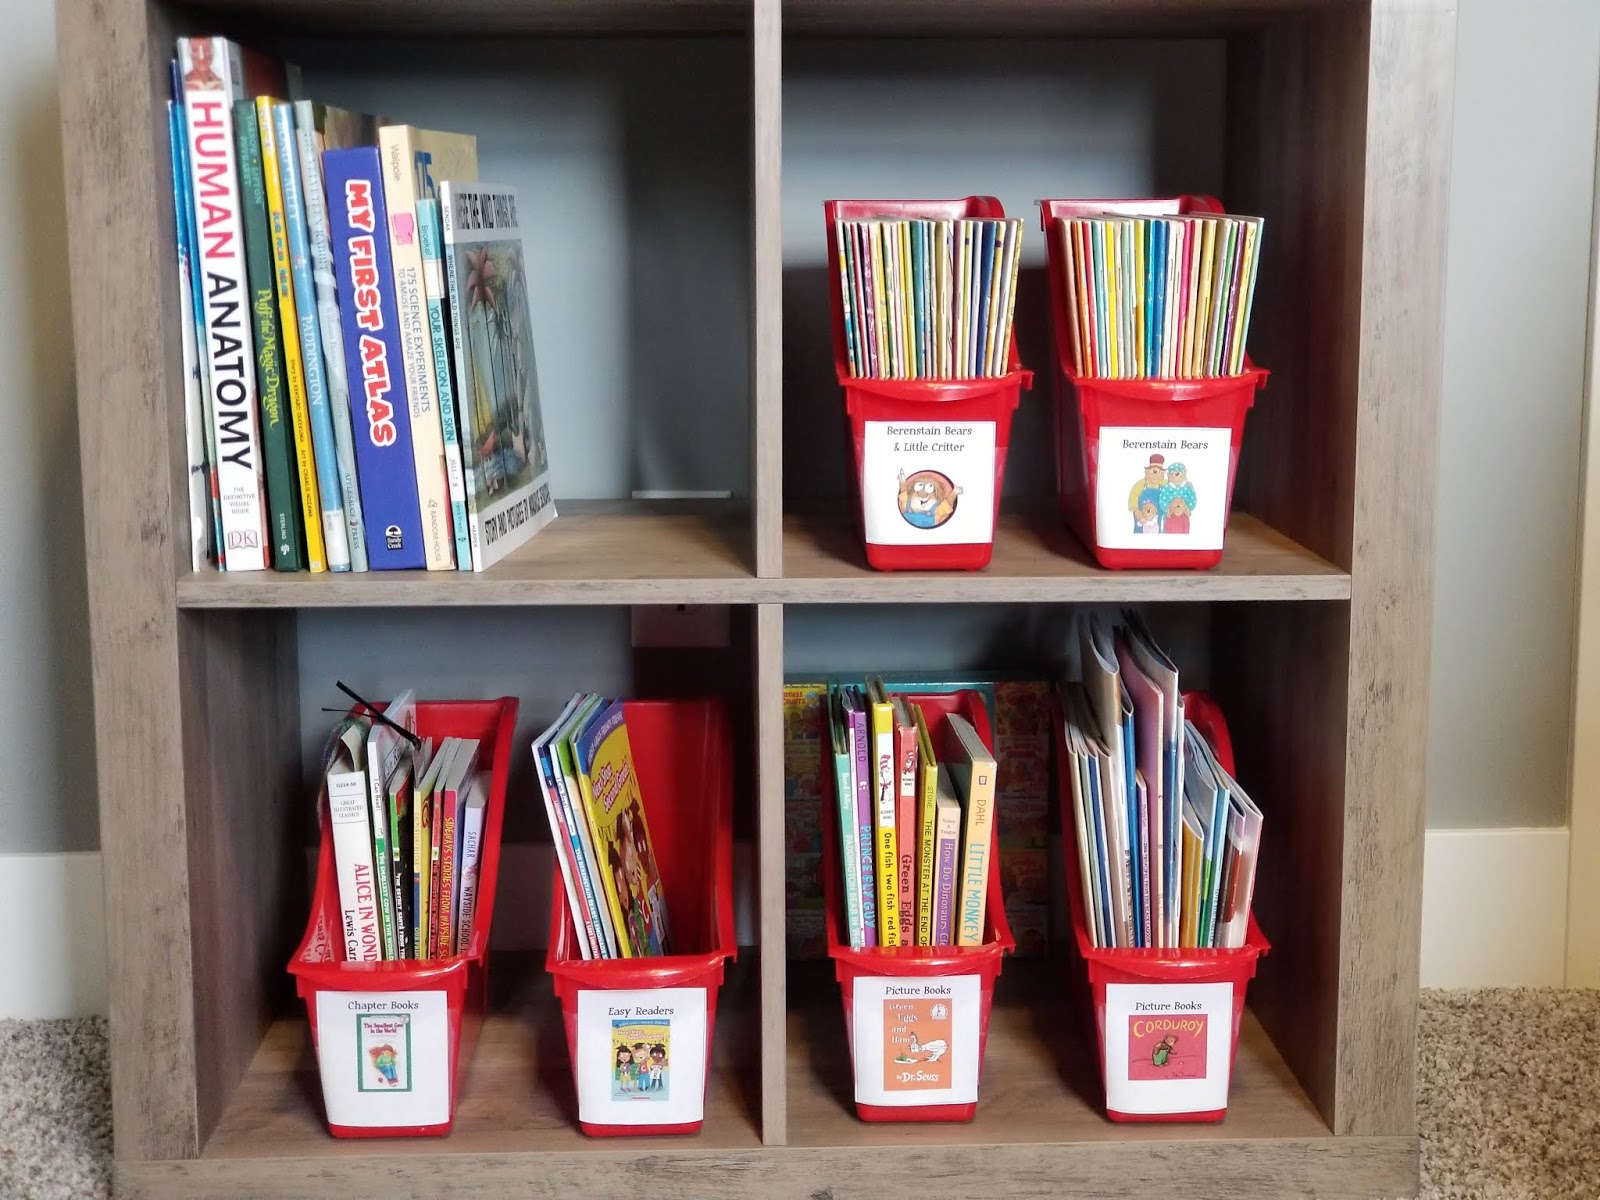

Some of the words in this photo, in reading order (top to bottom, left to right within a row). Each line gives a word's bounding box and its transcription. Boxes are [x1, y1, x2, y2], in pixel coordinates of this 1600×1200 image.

[390, 144, 401, 182] Walpole
[192, 102, 236, 259] HUMAN
[348, 182, 374, 231] MY
[350, 238, 381, 329] FIRST
[398, 267, 405, 279] TO
[407, 267, 417, 285] 175
[255, 289, 273, 318] Puff
[400, 281, 408, 309] AMUSE
[402, 312, 410, 329] AND
[409, 288, 421, 333] SCIENCE
[430, 306, 441, 333] YOUR
[260, 333, 275, 372] Magic
[404, 331, 413, 360] AMAZE
[207, 271, 252, 470] ANATOMY
[302, 315, 323, 405] PADDINGTON
[407, 362, 416, 384] YOUR
[433, 338, 448, 387] SKELETON
[414, 337, 430, 412] EXPERIMENTS
[263, 373, 280, 430] Dragon
[361, 337, 394, 444] ATLAS
[409, 386, 420, 419] FRIENDS
[441, 391, 452, 416] AND
[445, 417, 456, 442] SKIN
[886, 426, 941, 436] Berenstain
[945, 426, 973, 436] Bears
[893, 442, 901, 452] &
[903, 442, 929, 452] Little
[931, 442, 965, 452] Critter
[1122, 439, 1177, 449] Berenstain
[1180, 440, 1210, 450] Bears
[229, 530, 257, 548] DK
[279, 512, 287, 540] STERLING
[351, 528, 360, 549] PRESS
[857, 722, 867, 763] ARNOLD
[975, 800, 987, 827] DAHL
[443, 817, 454, 854] SIDEWAYS
[884, 832, 893, 849] One
[925, 820, 933, 837] THE
[467, 831, 477, 859] SACHAR
[860, 825, 873, 871] PRINCE
[945, 842, 953, 863] How
[442, 855, 453, 889] STORIES
[845, 834, 858, 890] PADDINGTON
[884, 851, 894, 869] fish
[922, 839, 932, 880] MONSTER
[943, 866, 952, 880] Do
[967, 842, 985, 885] LITTLE
[354, 863, 374, 904] ALICE
[578, 862, 593, 899] BERENSTAIN
[862, 875, 875, 899] FLY
[901, 854, 913, 893] Green
[921, 882, 930, 894] AT
[358, 905, 375, 921] IN
[380, 865, 389, 898] SMALLEST
[387, 938, 395, 961] WORLD
[441, 890, 452, 914] FROM
[462, 886, 474, 918] WAYSIDE
[849, 892, 859, 917] BEAR
[863, 902, 876, 928] GUY
[886, 893, 896, 911] fish
[920, 897, 929, 914] THE
[941, 883, 951, 930] Dinosaurs
[345, 909, 358, 937] Lewis
[398, 912, 406, 930] SANTA
[887, 916, 896, 931] red
[899, 900, 914, 933] Eggs
[920, 916, 928, 933] END
[963, 889, 981, 943] MONKEY
[440, 915, 450, 948] WAYSIDE
[460, 919, 471, 947] SCHOOL
[919, 935, 927, 946] OF
[885, 985, 921, 995] Picture
[924, 985, 952, 995] Books
[348, 1000, 388, 1012] Chapter
[392, 1001, 420, 1010] Books
[608, 1007, 632, 1018] Easy
[635, 1006, 676, 1016] Readers
[890, 1003, 914, 1011] Green
[1135, 1001, 1171, 1011] Picture
[1174, 1001, 1203, 1011] Books
[891, 1025, 907, 1033] and
[892, 1036, 910, 1044] Ham
[1133, 1019, 1205, 1039] CORDUROY
[902, 1071, 916, 1082] Dr.
[916, 1070, 939, 1082] Seuss
